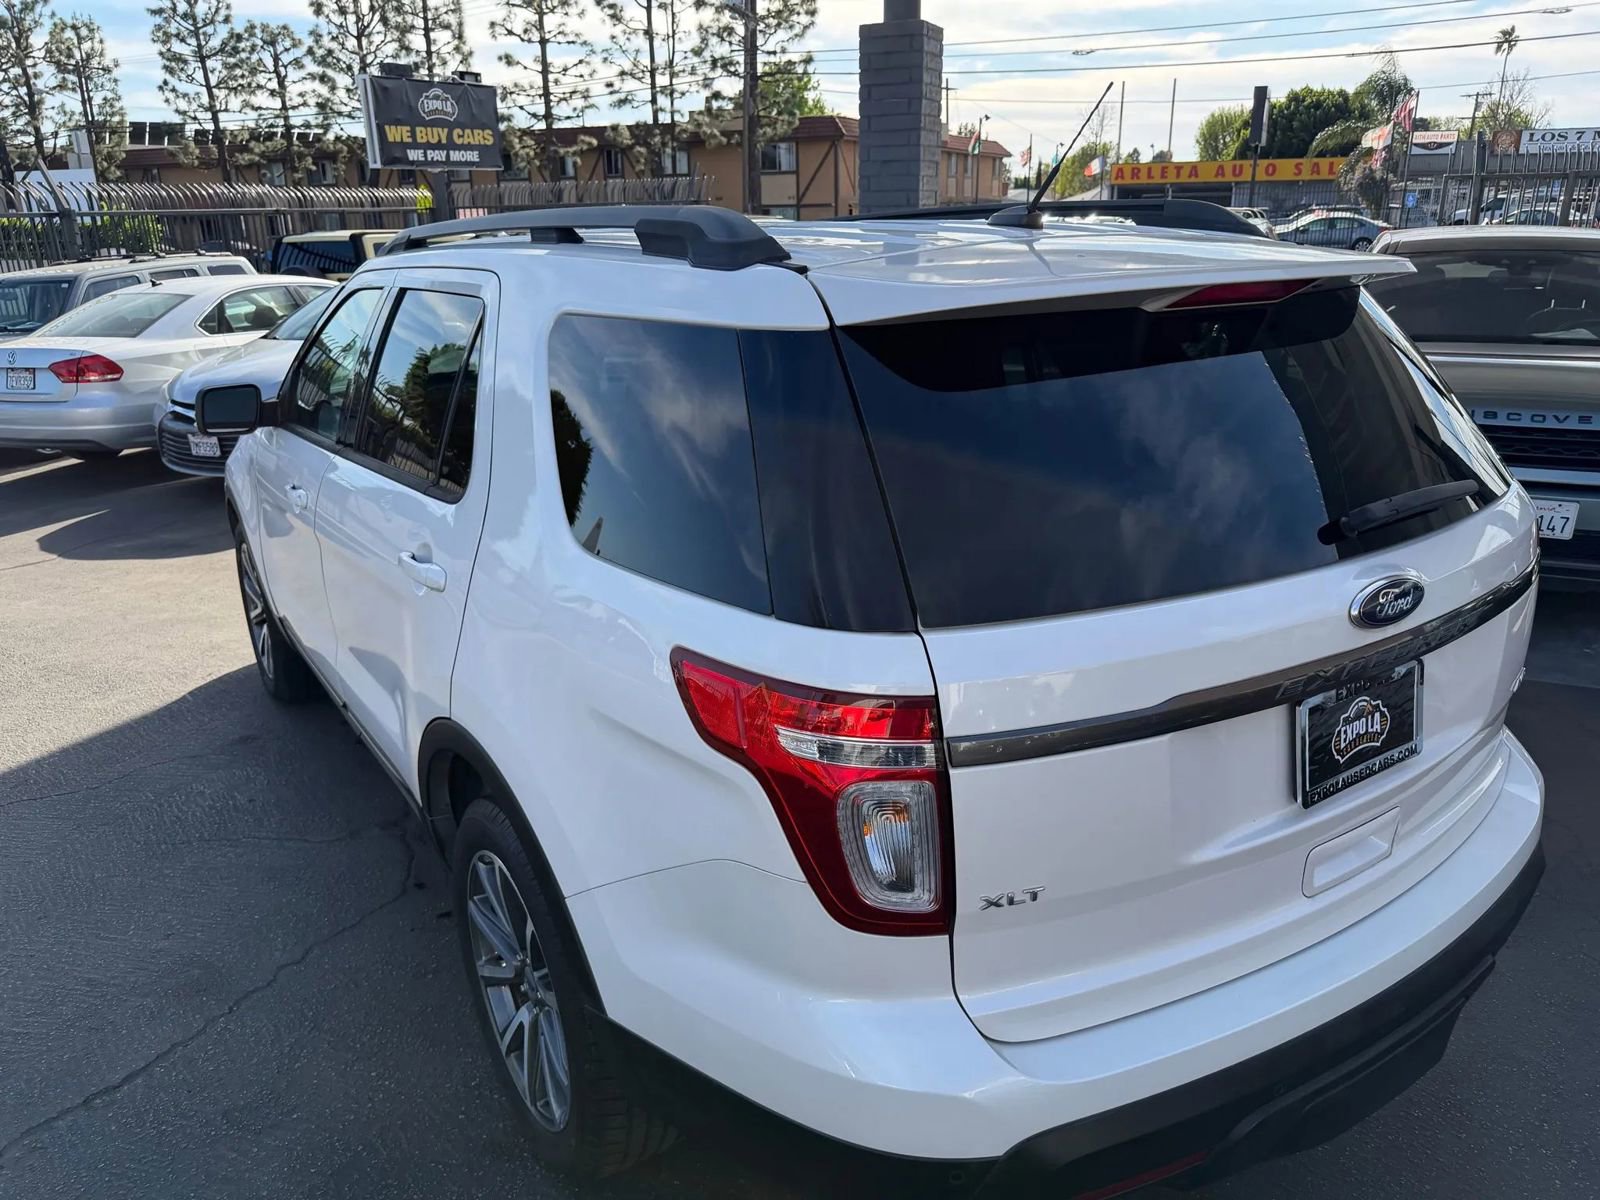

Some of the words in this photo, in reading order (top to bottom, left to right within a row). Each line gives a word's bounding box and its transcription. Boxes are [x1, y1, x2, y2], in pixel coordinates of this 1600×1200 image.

[424, 99, 442, 112] EXPO
[443, 100, 453, 114] LA
[384, 125, 412, 142] WE
[415, 127, 448, 143] BUY
[452, 128, 494, 145] CARS
[1440, 132, 1456, 140] PARTS
[1528, 131, 1568, 142] LOS
[1575, 130, 1586, 141] 7
[406, 149, 425, 161] WE
[427, 149, 447, 161] PAY
[449, 150, 480, 162] MORE
[1114, 165, 1200, 181] ARLETA
[1214, 163, 1277, 179] AUO
[1292, 161, 1337, 177] SAL
[1471, 409, 1593, 425] ISCOVE
[1538, 515, 1570, 533] 147
[1376, 587, 1414, 617] Ford
[1341, 716, 1366, 747] EXPO
[1368, 712, 1381, 732] LA
[1309, 743, 1418, 805] EXPOLAUSEDCARS.COM
[979, 886, 1046, 911] XLT
